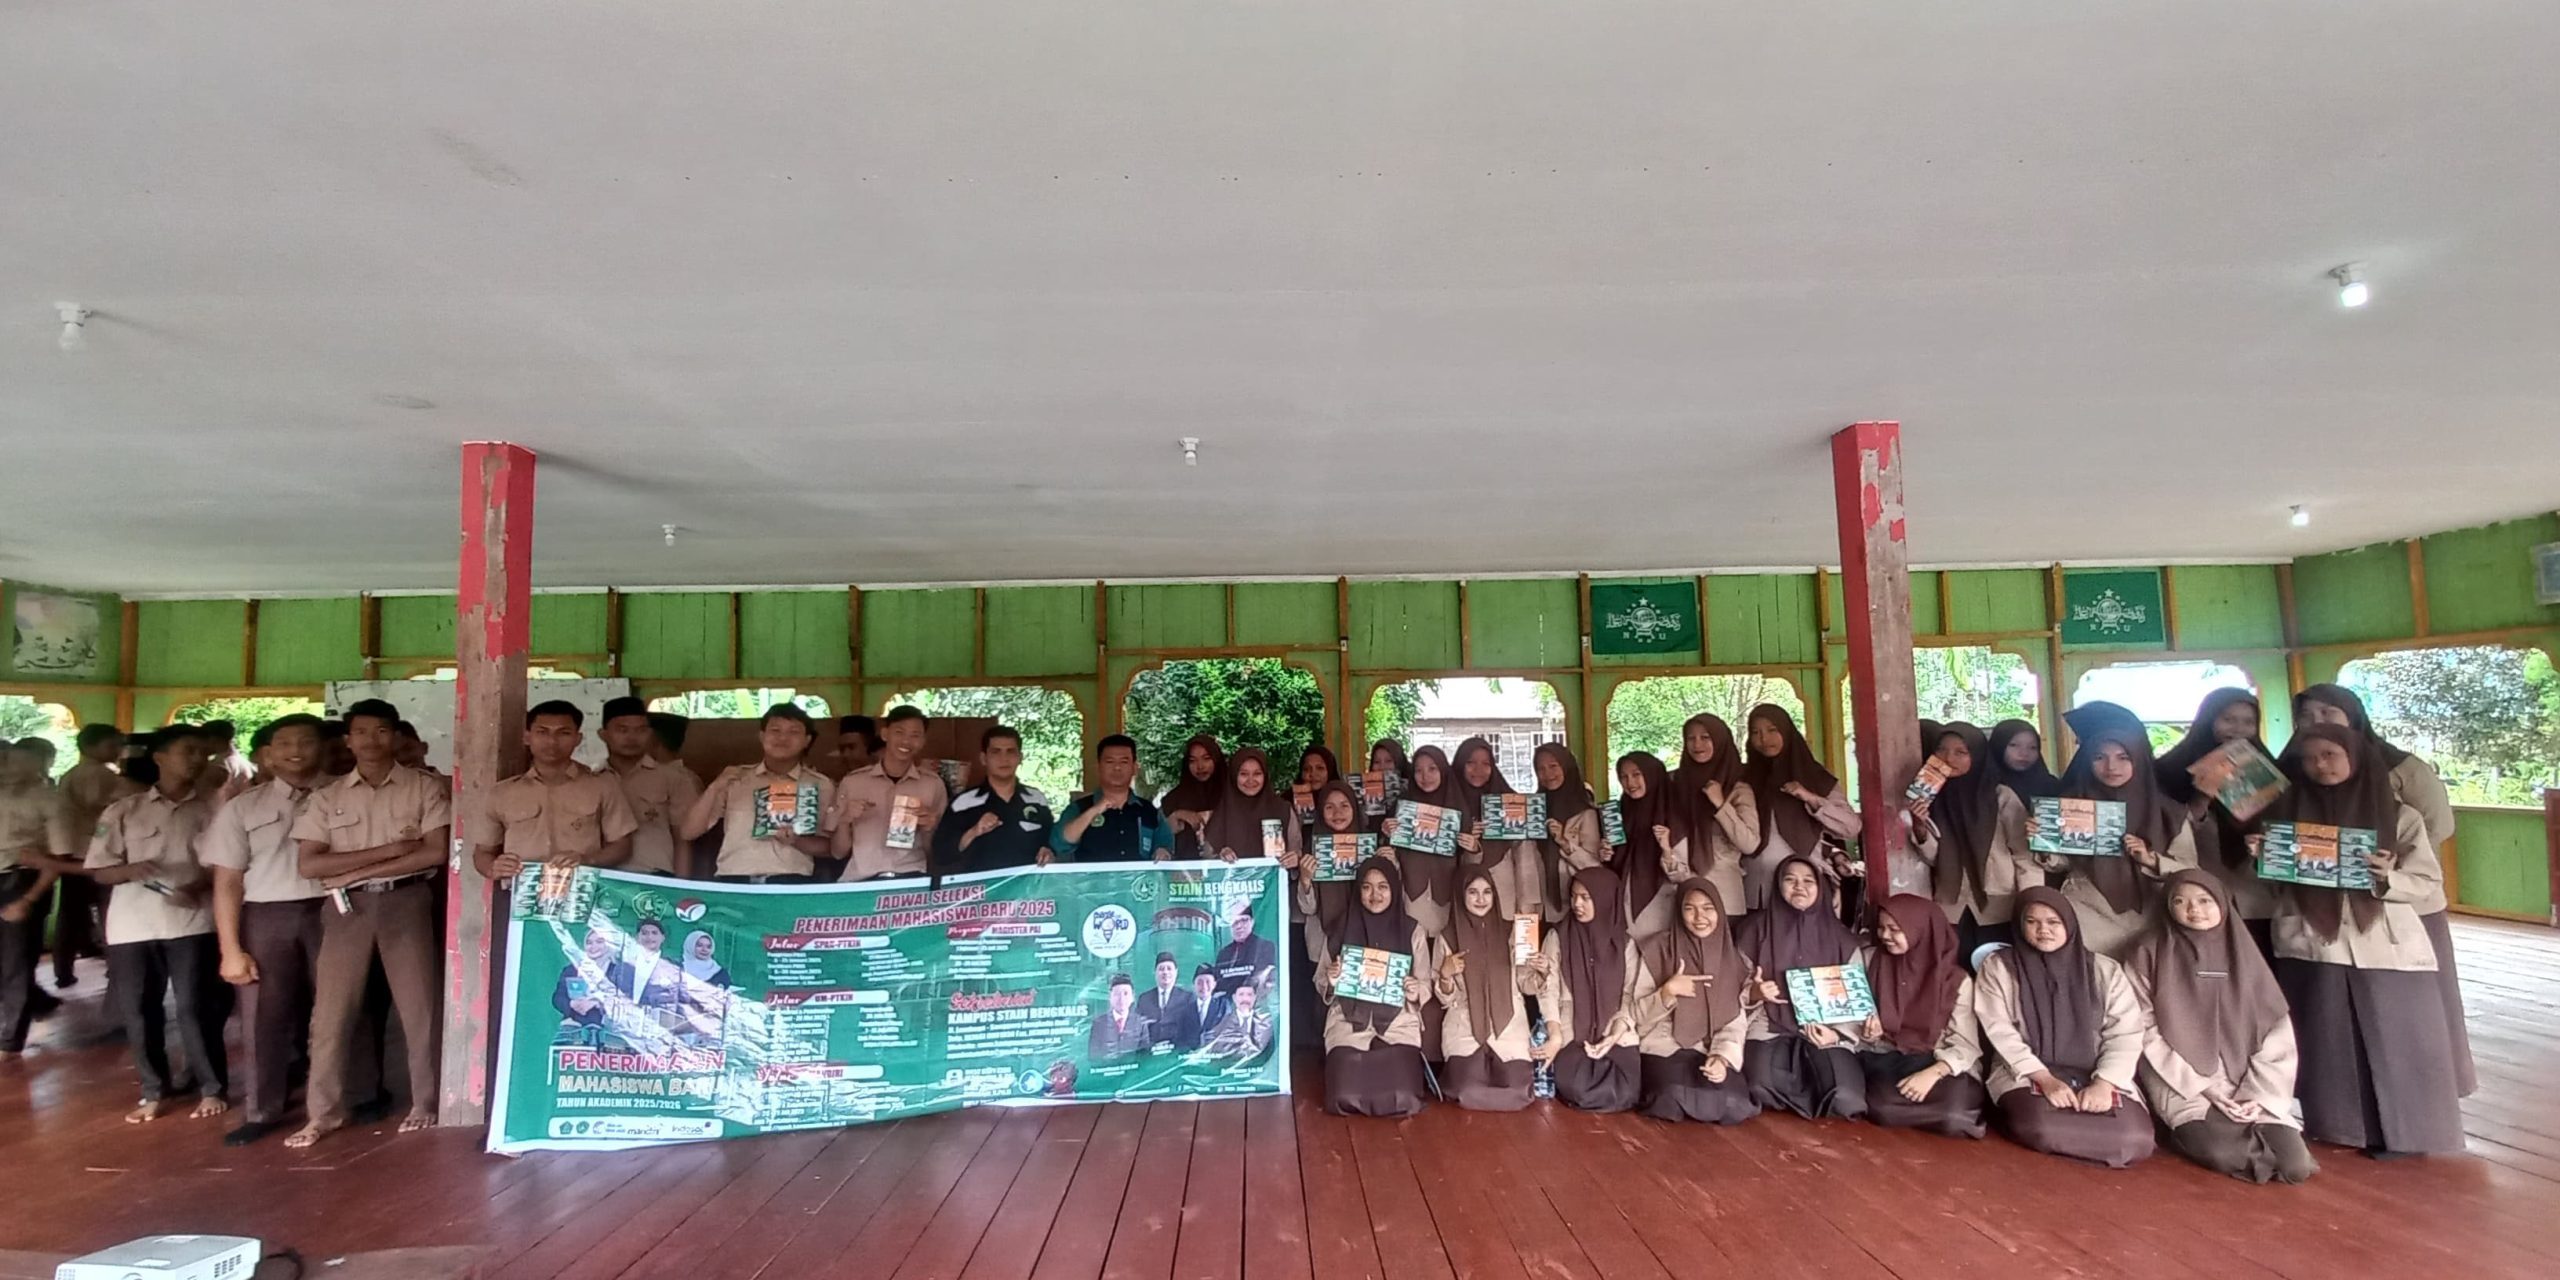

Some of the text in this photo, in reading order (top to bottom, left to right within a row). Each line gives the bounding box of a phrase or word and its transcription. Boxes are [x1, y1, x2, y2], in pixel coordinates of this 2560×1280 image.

[1169, 879, 1265, 896] STAIN BENGKALIS
[876, 885, 986, 912] JADWAL SELEKSI
[795, 914, 888, 934] PENERIMAAN
[890, 905, 978, 930] MAHASISWA
[1019, 901, 1055, 918] 2025
[948, 1004, 1089, 1025] KAMPUS STAIN BENGKALIS
[557, 1075, 665, 1096] MAHASISWA
[556, 1097, 682, 1109] TAHUN AKADEMIK 2025/2026
